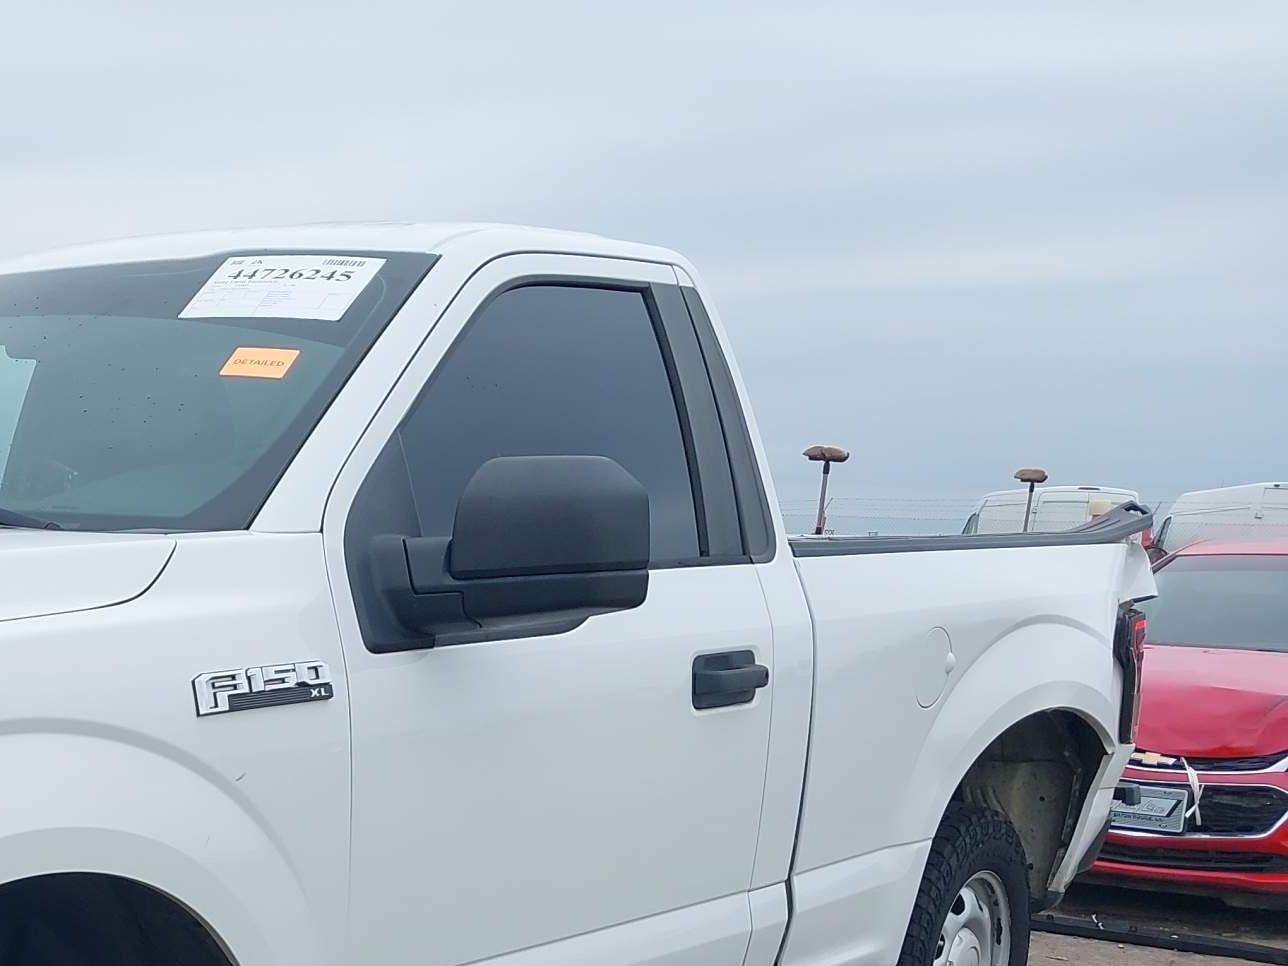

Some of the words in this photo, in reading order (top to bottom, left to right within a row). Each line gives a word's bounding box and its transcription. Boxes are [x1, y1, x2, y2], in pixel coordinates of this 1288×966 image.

[227, 268, 356, 282] 44726245
[233, 357, 285, 368] DETAILED
[192, 659, 331, 716] F150
[310, 687, 329, 698] XL
